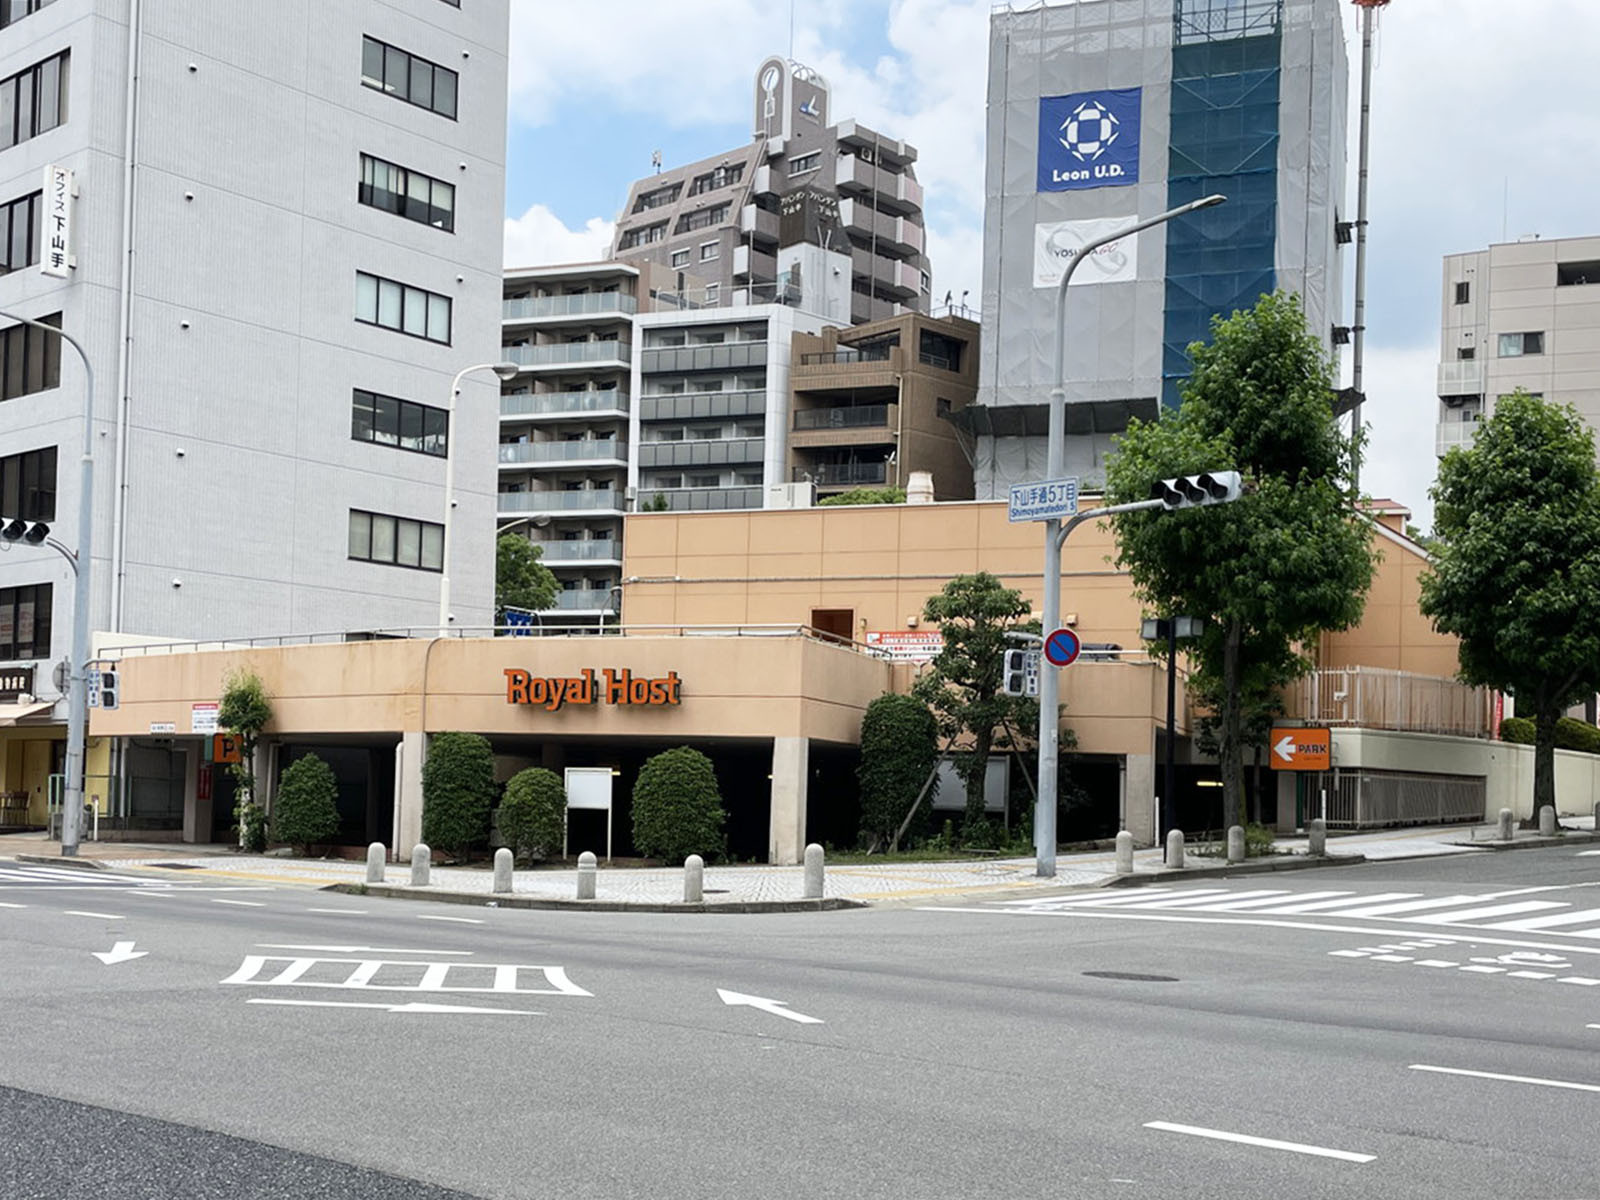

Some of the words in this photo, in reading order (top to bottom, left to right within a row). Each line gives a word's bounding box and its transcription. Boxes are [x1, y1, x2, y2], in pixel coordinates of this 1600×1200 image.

[1052, 169, 1090, 182] Leon
[1094, 164, 1125, 178] U.D.
[1012, 483, 1075, 506] 下山手通5丁目
[503, 668, 598, 711] Royal
[602, 668, 682, 705] Host
[222, 738, 235, 758] P
[1299, 744, 1327, 754] PARK
